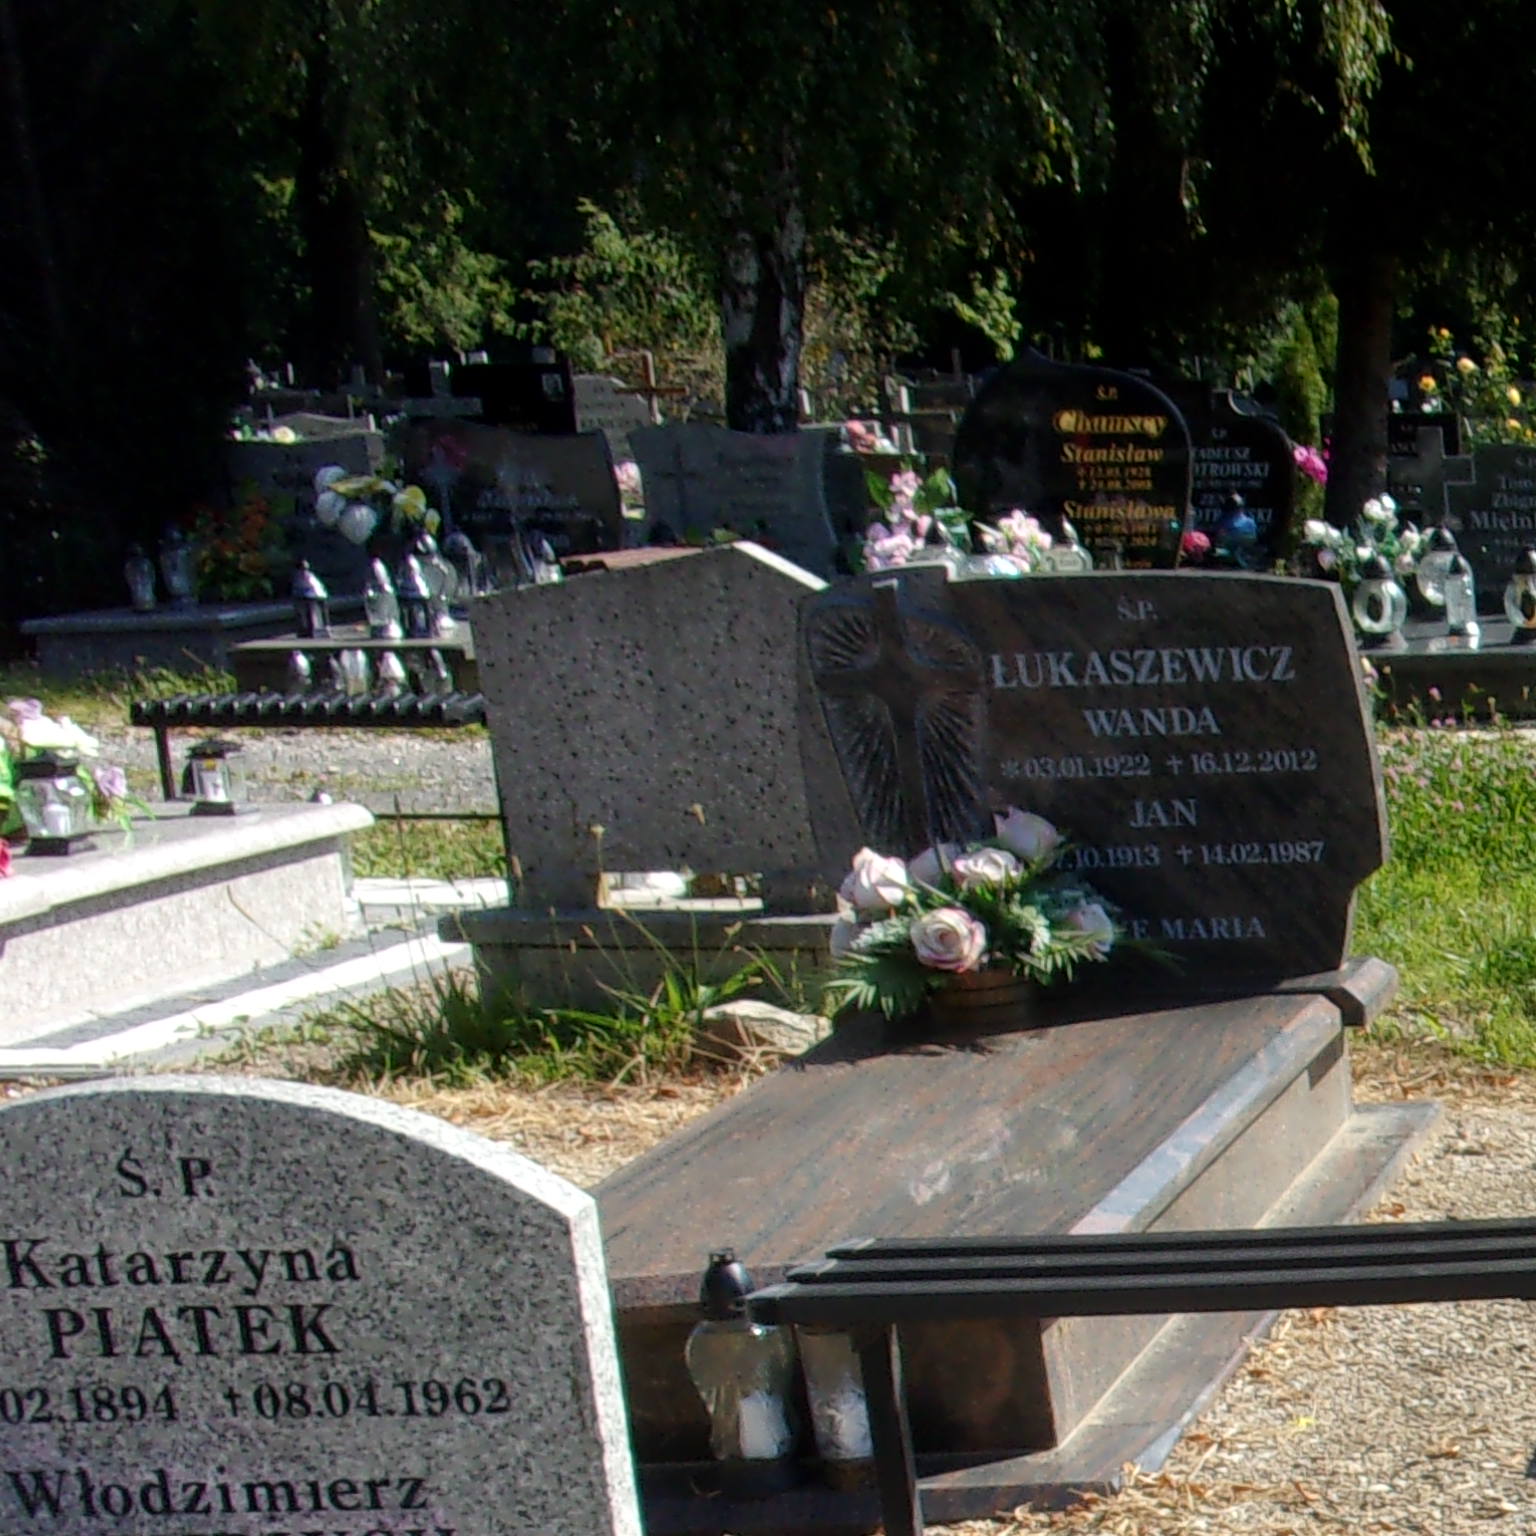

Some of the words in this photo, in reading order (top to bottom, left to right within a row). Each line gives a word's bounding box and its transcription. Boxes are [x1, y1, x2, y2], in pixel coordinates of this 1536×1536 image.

[1117, 596, 1158, 621] Ś.P.
[992, 646, 1296, 689] ŁUKASZEWICZ
[1083, 706, 1221, 738] WANDA
[1129, 798, 1199, 830] JAN
[1052, 844, 1161, 871] 7.10.1913
[1161, 916, 1267, 941] MARIA
[2, 1238, 361, 1296] Katarzyna
[43, 1303, 342, 1366] PIĄTEK
[5, 1466, 429, 1519] Włodzimierz
